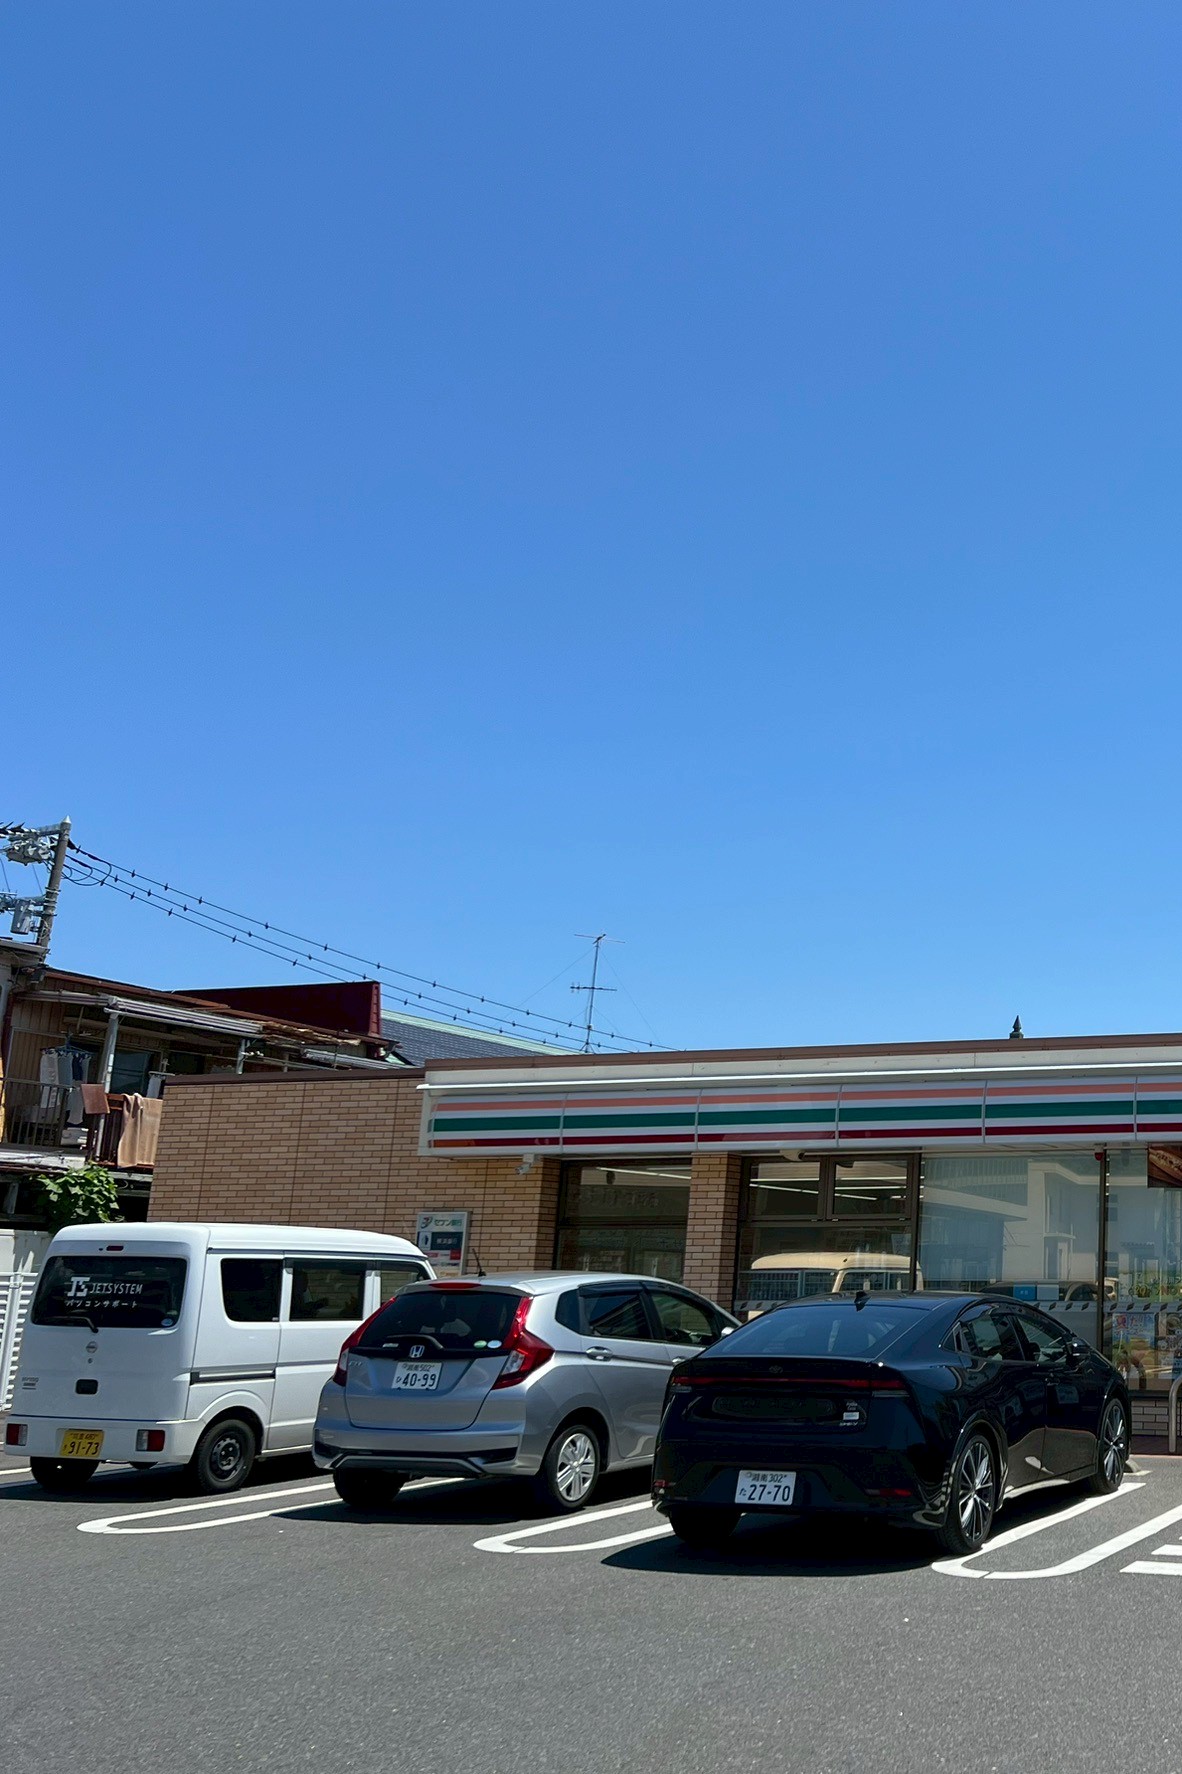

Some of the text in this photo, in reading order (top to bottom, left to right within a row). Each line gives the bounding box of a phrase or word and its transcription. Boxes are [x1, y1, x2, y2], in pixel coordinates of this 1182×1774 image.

[89, 1283, 143, 1295] JETSYSTEM
[65, 1299, 138, 1308] パソコンサポート
[402, 1373, 437, 1387] 40-99
[68, 1441, 100, 1455] 91-73
[747, 1484, 791, 1503] 27-70
